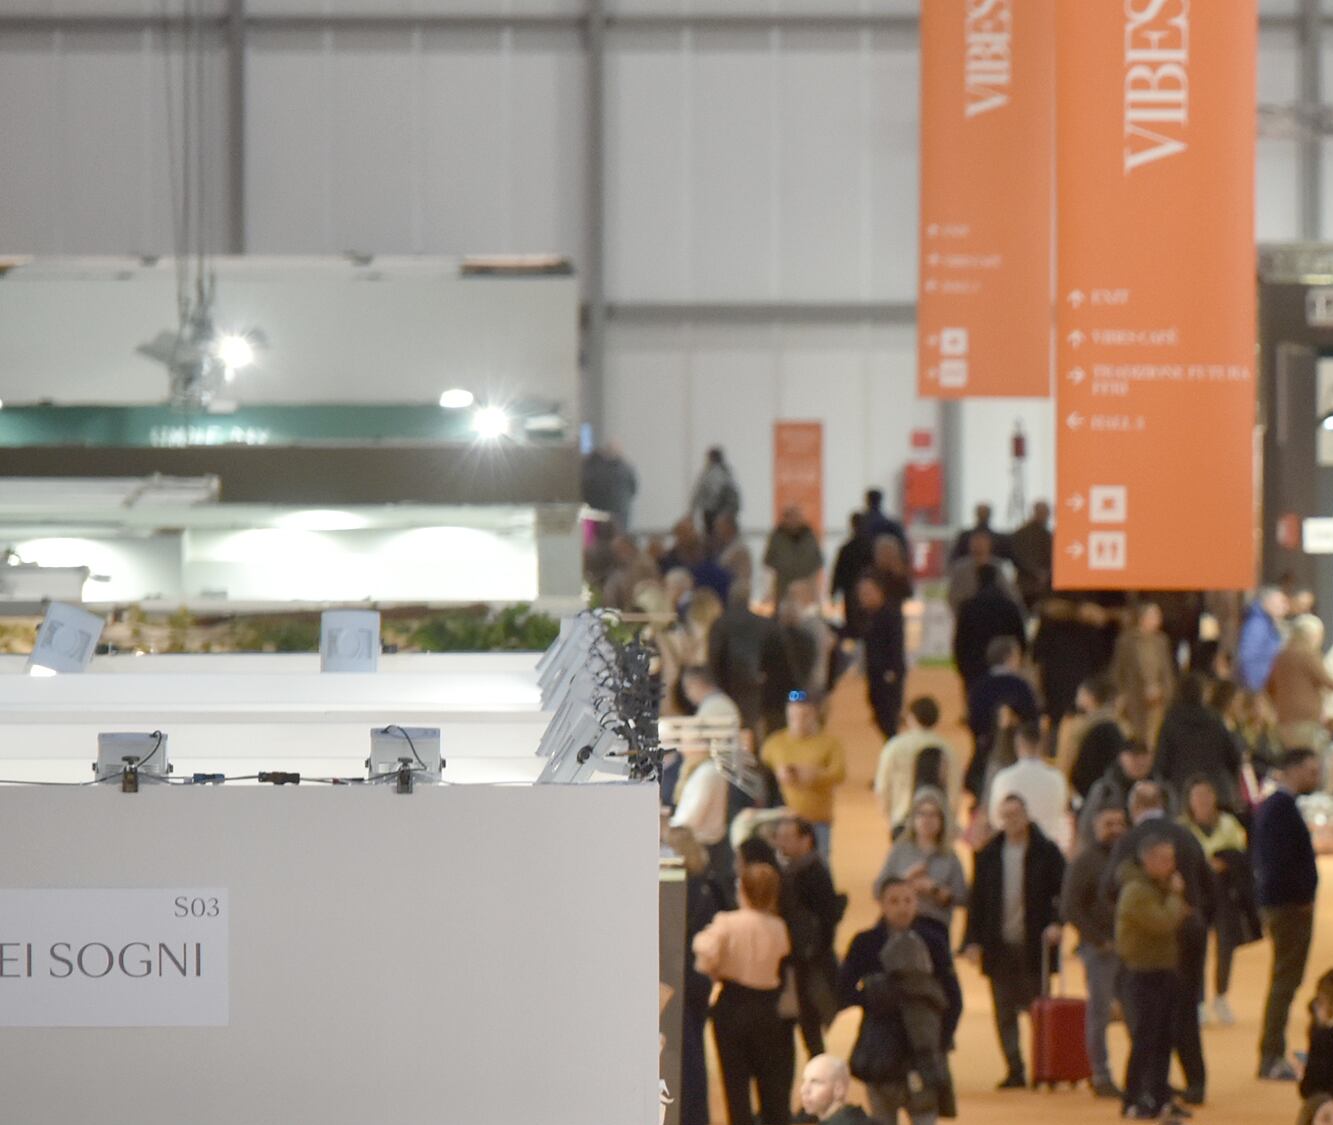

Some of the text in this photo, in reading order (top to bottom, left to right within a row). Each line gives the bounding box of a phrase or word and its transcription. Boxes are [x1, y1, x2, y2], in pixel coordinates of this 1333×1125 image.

[1123, 0, 1189, 176] VIBES
[173, 896, 220, 918] S03
[0, 942, 202, 978] EI SOGNI
